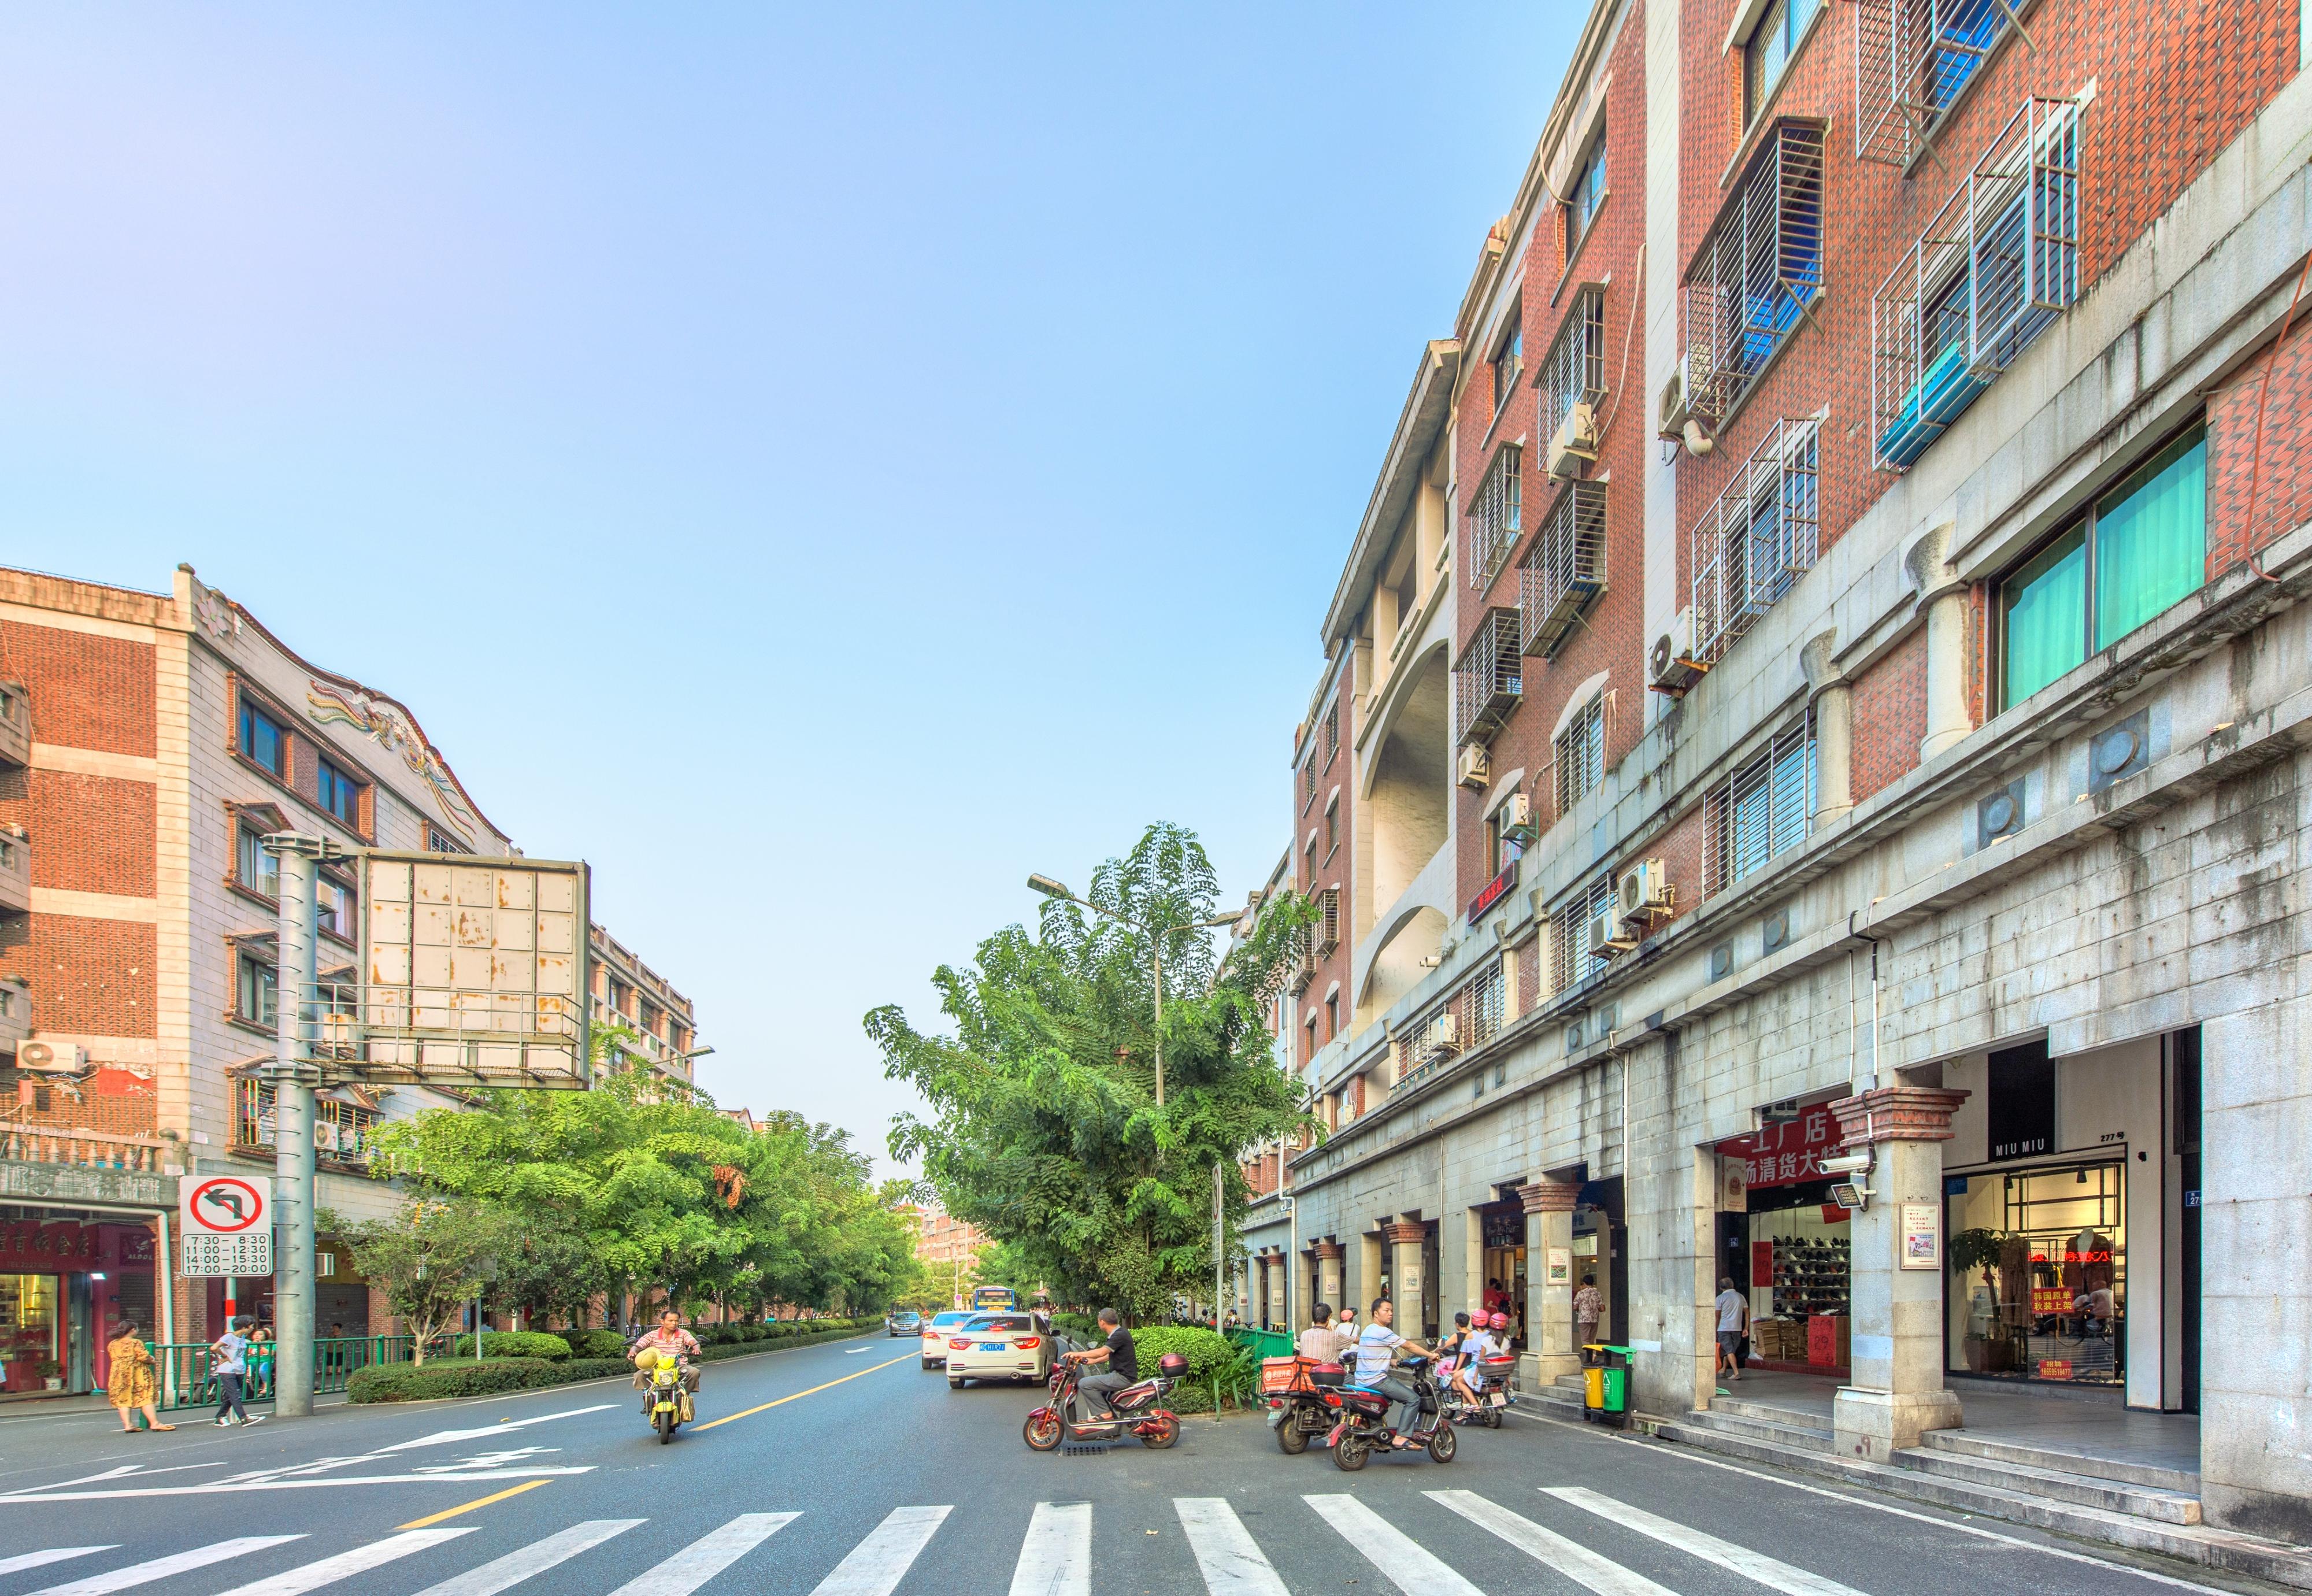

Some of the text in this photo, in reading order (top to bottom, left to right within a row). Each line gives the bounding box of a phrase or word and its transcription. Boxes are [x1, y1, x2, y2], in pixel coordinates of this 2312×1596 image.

[1752, 1111, 1827, 1153] 工厂店
[2100, 1131, 2125, 1142] 277号
[1996, 1138, 2045, 1156] MIU MIU
[2033, 1291, 2071, 1301] 韩国原单
[2034, 1302, 2072, 1310] 秋装上架
[1814, 1336, 1829, 1350] 29
